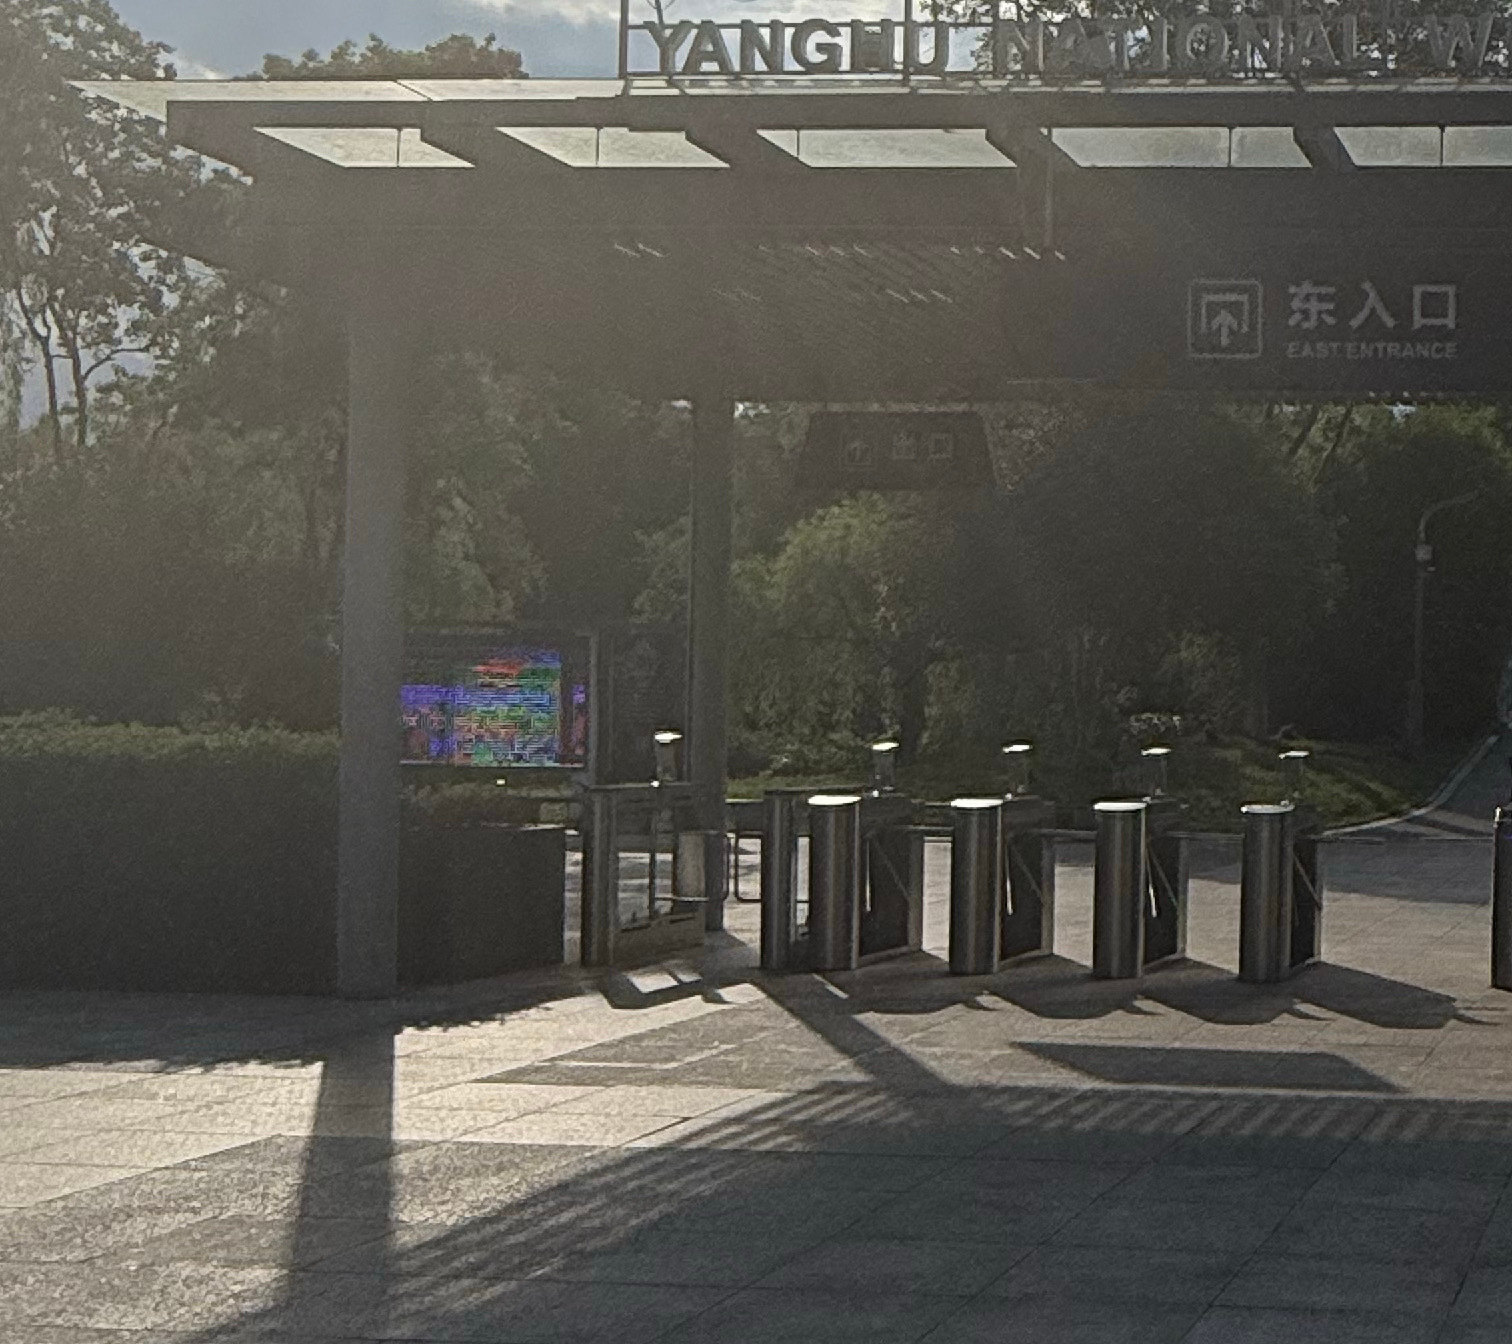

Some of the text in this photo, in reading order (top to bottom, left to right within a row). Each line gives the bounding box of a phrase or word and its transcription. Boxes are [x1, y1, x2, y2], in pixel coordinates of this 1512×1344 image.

[641, 18, 951, 74] YANGHU
[992, 13, 1382, 72] NATIONAL
[1287, 279, 1457, 330] 东入口
[1286, 341, 1458, 359] EAST ENTRANCE
